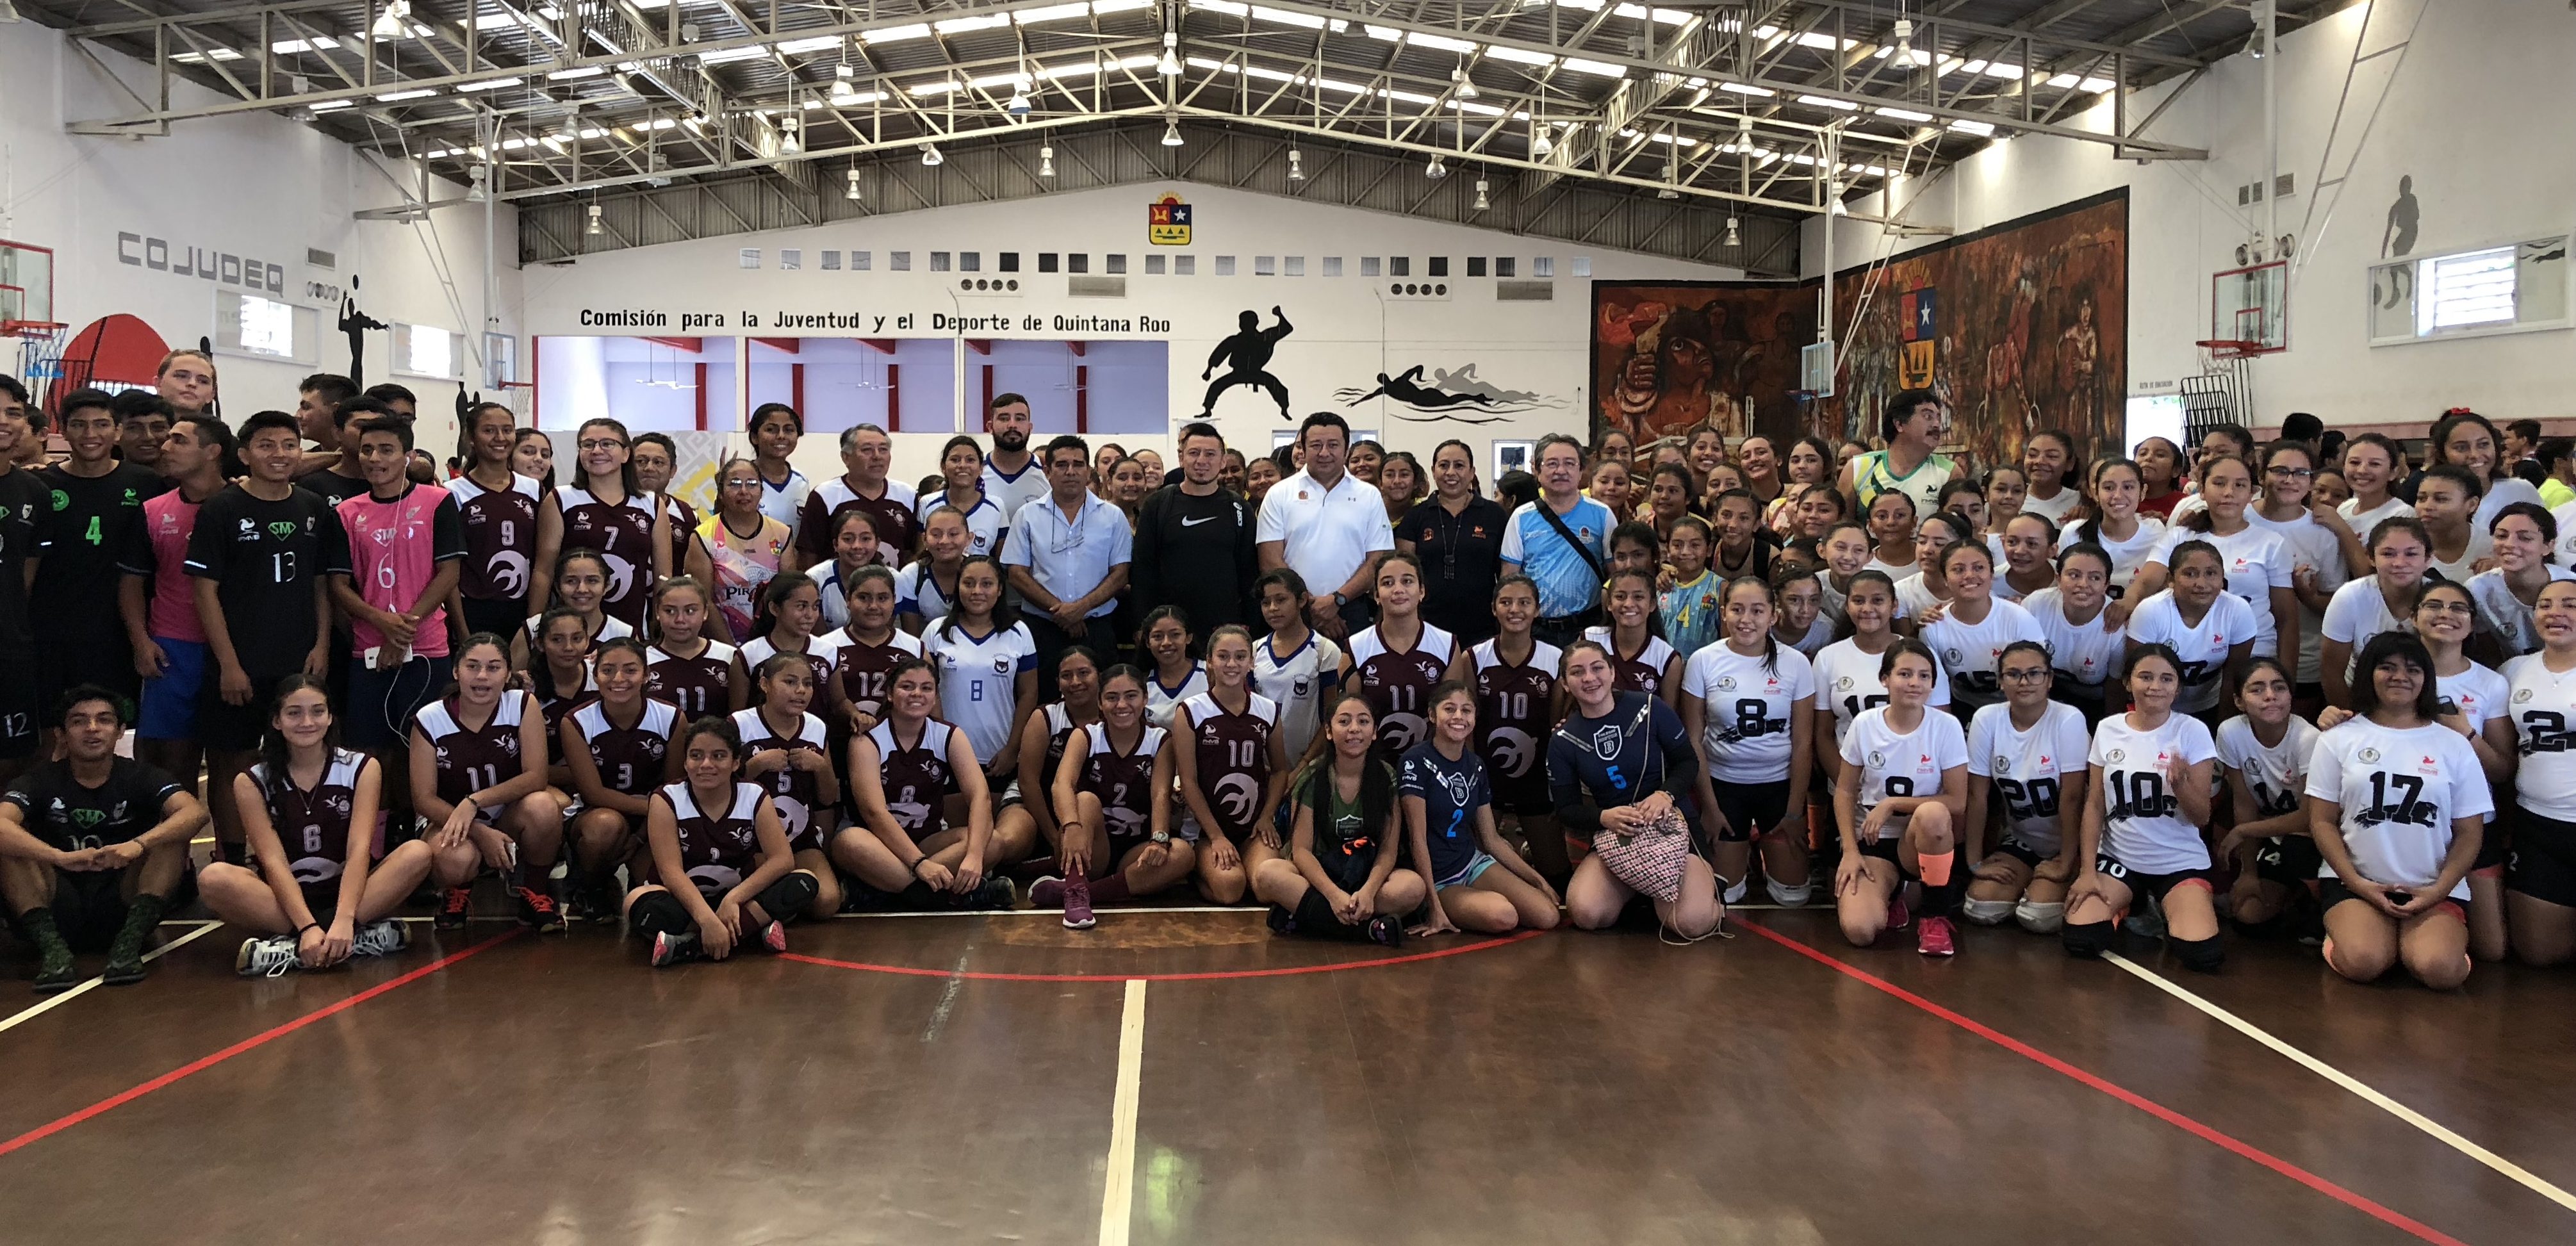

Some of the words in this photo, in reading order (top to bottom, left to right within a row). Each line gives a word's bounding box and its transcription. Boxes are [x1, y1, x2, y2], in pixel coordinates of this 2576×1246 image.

[118, 231, 284, 298] COJUDEQ
[580, 309, 667, 327] Comisión
[682, 313, 725, 331] para
[742, 311, 759, 327] la
[774, 311, 860, 329] Juventud
[873, 315, 886, 333] y
[898, 313, 914, 329] el
[933, 313, 1010, 334] Deporte
[1022, 315, 1042, 331] de
[1053, 315, 1131, 332] Quintana
[1140, 316, 1170, 333] Roo
[86, 516, 103, 545] 4
[270, 522, 292, 534] SM
[501, 520, 514, 546] 9
[604, 526, 619, 550] 7
[272, 552, 296, 582] 13
[377, 553, 395, 589] 6
[1677, 603, 1689, 628] 4
[858, 671, 887, 697] 12
[971, 680, 982, 701] 8
[1390, 684, 1415, 711] 11
[676, 685, 705, 711] 11
[1499, 691, 1528, 719] 10
[4, 712, 30, 737] 12
[1735, 698, 1767, 737] 8
[2523, 710, 2565, 752] 2
[1228, 740, 1255, 767] 10
[1604, 741, 1614, 754] B
[466, 764, 497, 792] 11
[616, 763, 632, 789] 3
[777, 766, 792, 793] 5
[1606, 765, 1627, 789] 5
[1112, 782, 1128, 806] 2
[1996, 777, 2060, 818] 20
[2110, 770, 2163, 818] 10
[2254, 782, 2299, 816] 14
[2370, 771, 2424, 824] 17
[1447, 808, 1464, 837] 2
[304, 824, 322, 853] 6
[2097, 860, 2126, 878] 10
[2509, 851, 2518, 871] 2
